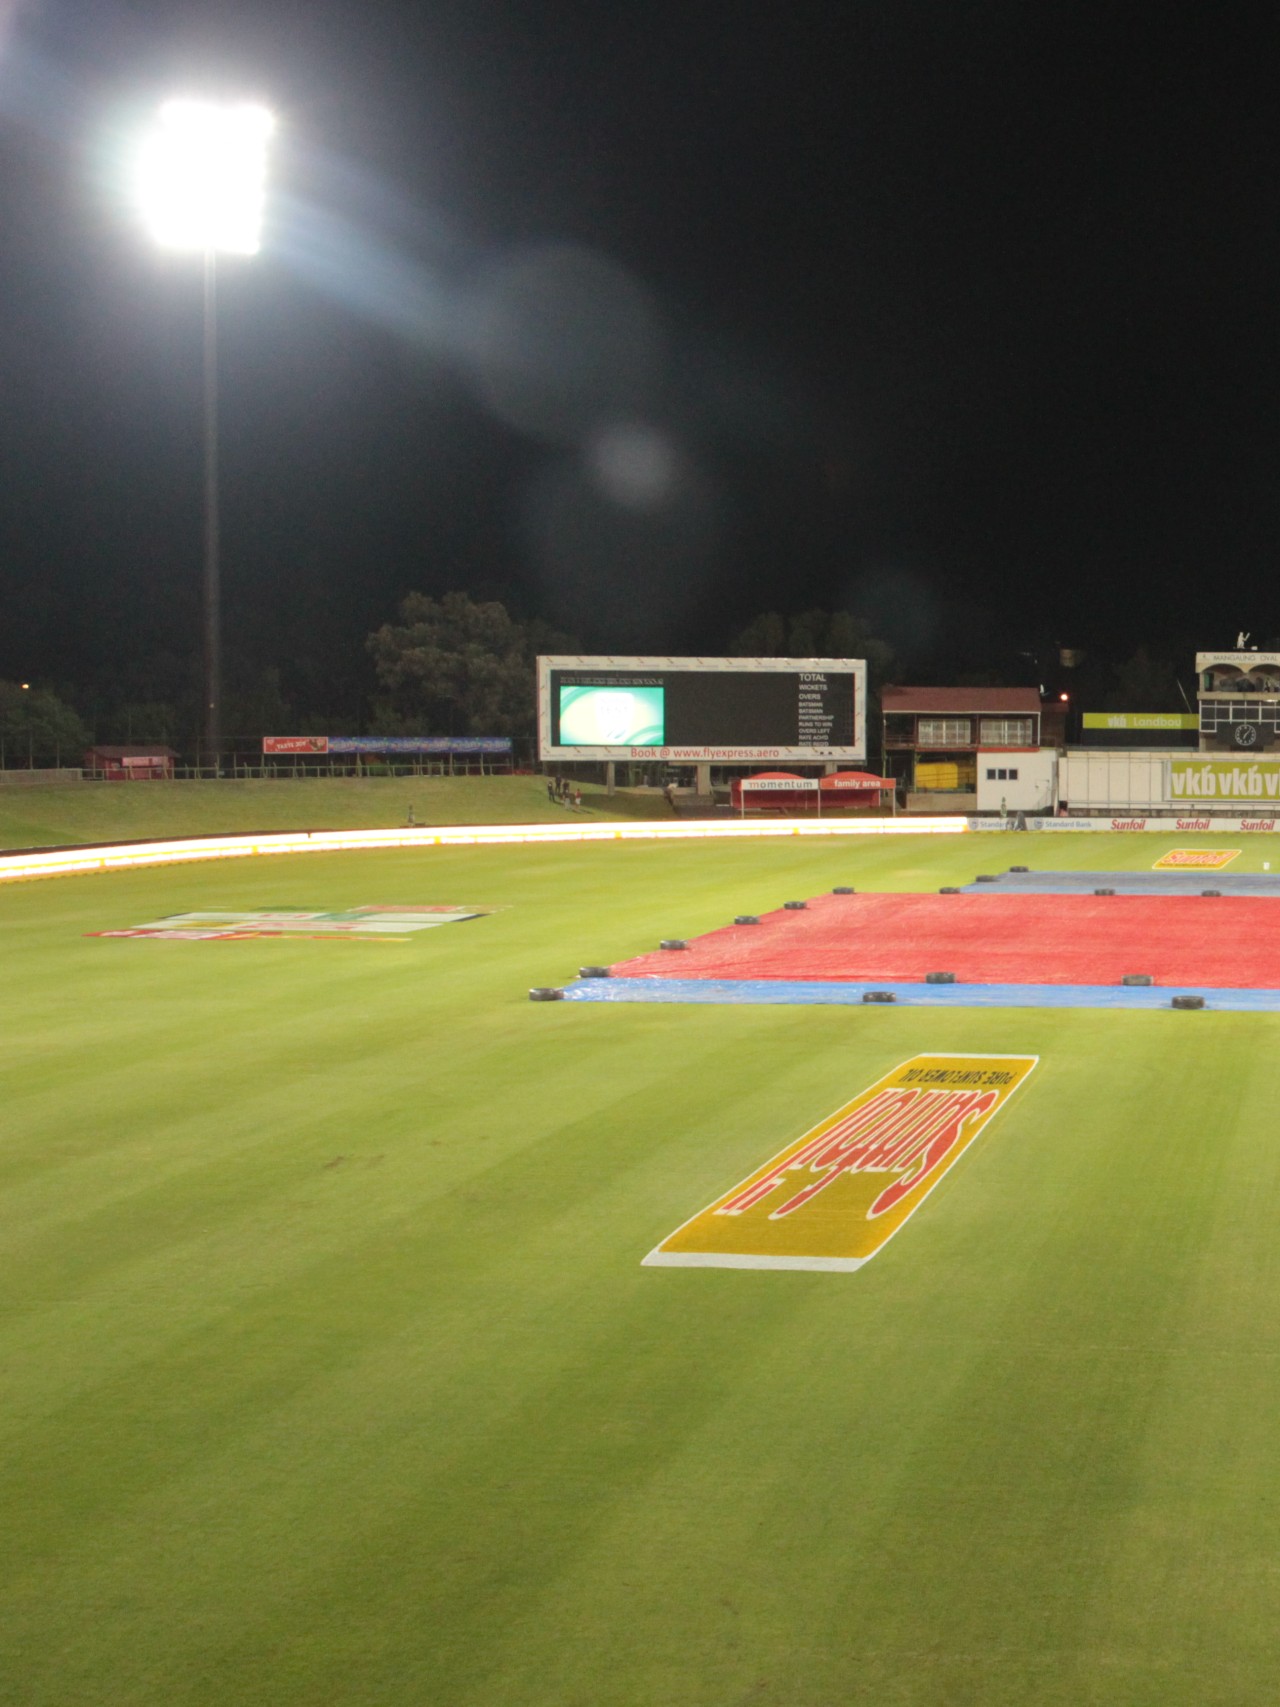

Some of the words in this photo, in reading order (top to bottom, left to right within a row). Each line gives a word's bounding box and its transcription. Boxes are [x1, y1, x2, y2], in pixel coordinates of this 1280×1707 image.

[800, 673, 826, 682] TOTAL
[1133, 715, 1181, 727] Landbou
[631, 748, 657, 758] Book
[659, 748, 671, 759] @
[673, 748, 780, 760] www.flyexpress.aero
[749, 780, 814, 789] momentum
[834, 779, 859, 788] family
[863, 780, 881, 788] area
[980, 820, 1009, 829] Standar
[1044, 820, 1075, 829] Standard
[1075, 821, 1092, 829] Bank
[1110, 819, 1146, 831] Sunfoil
[1175, 819, 1211, 831] Sunfoil
[1239, 820, 1275, 832] Sunfoil
[712, 1087, 1000, 1221] Sunfoil
